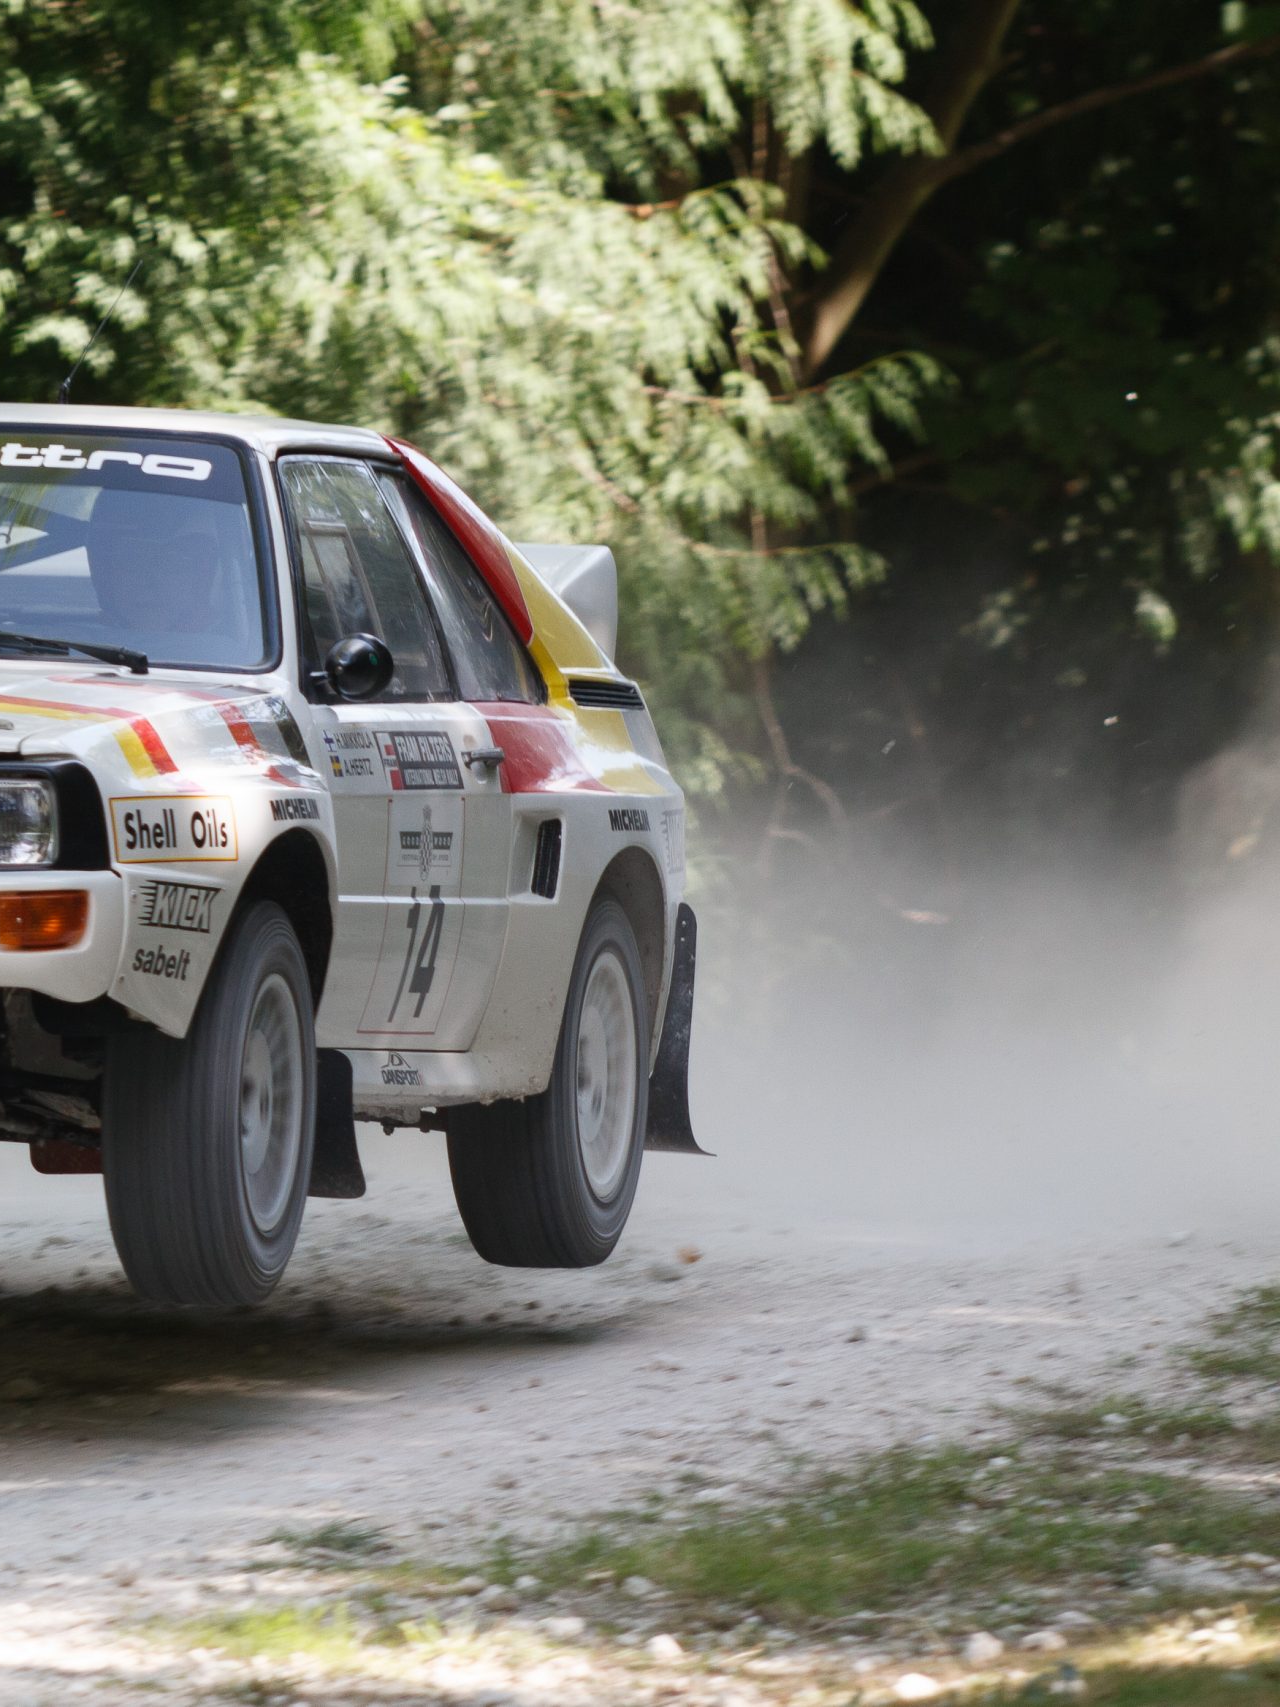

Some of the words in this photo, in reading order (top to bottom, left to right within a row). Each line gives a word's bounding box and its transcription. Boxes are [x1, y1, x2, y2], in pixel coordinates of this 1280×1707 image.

[269, 798, 320, 821] MICHELIN
[608, 809, 651, 831] MICHELIN
[124, 808, 177, 849] Shell
[191, 808, 228, 849] Oils
[132, 944, 190, 980] sabelt
[387, 885, 445, 1023] 14
